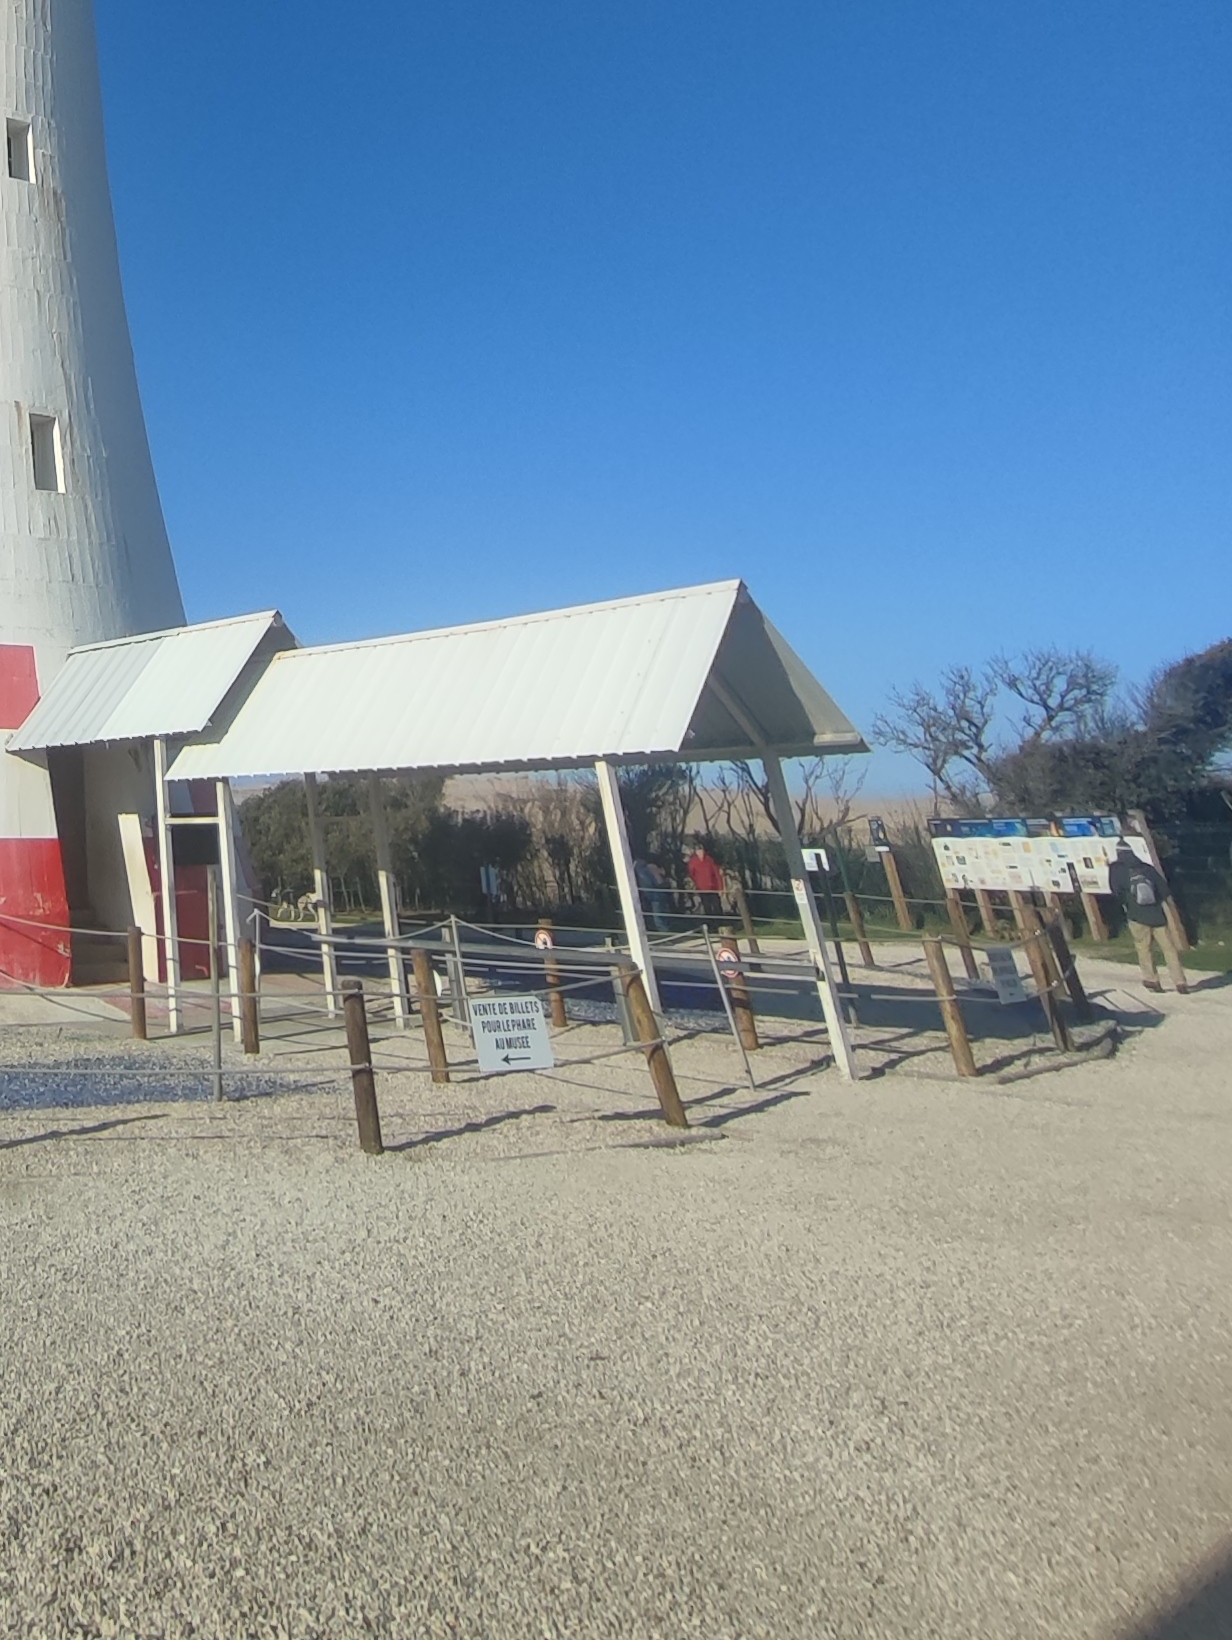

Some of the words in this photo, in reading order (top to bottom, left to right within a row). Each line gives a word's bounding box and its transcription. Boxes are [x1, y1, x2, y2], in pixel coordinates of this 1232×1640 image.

[472, 1003, 497, 1016] VENTE
[498, 1002, 508, 1015] DE
[509, 1001, 539, 1014] BILLETS
[481, 1020, 502, 1033] POUR
[502, 1019, 511, 1032] LE
[511, 1018, 537, 1031] PHARE
[495, 1037, 505, 1050] AU
[505, 1036, 531, 1049] MUSEE
